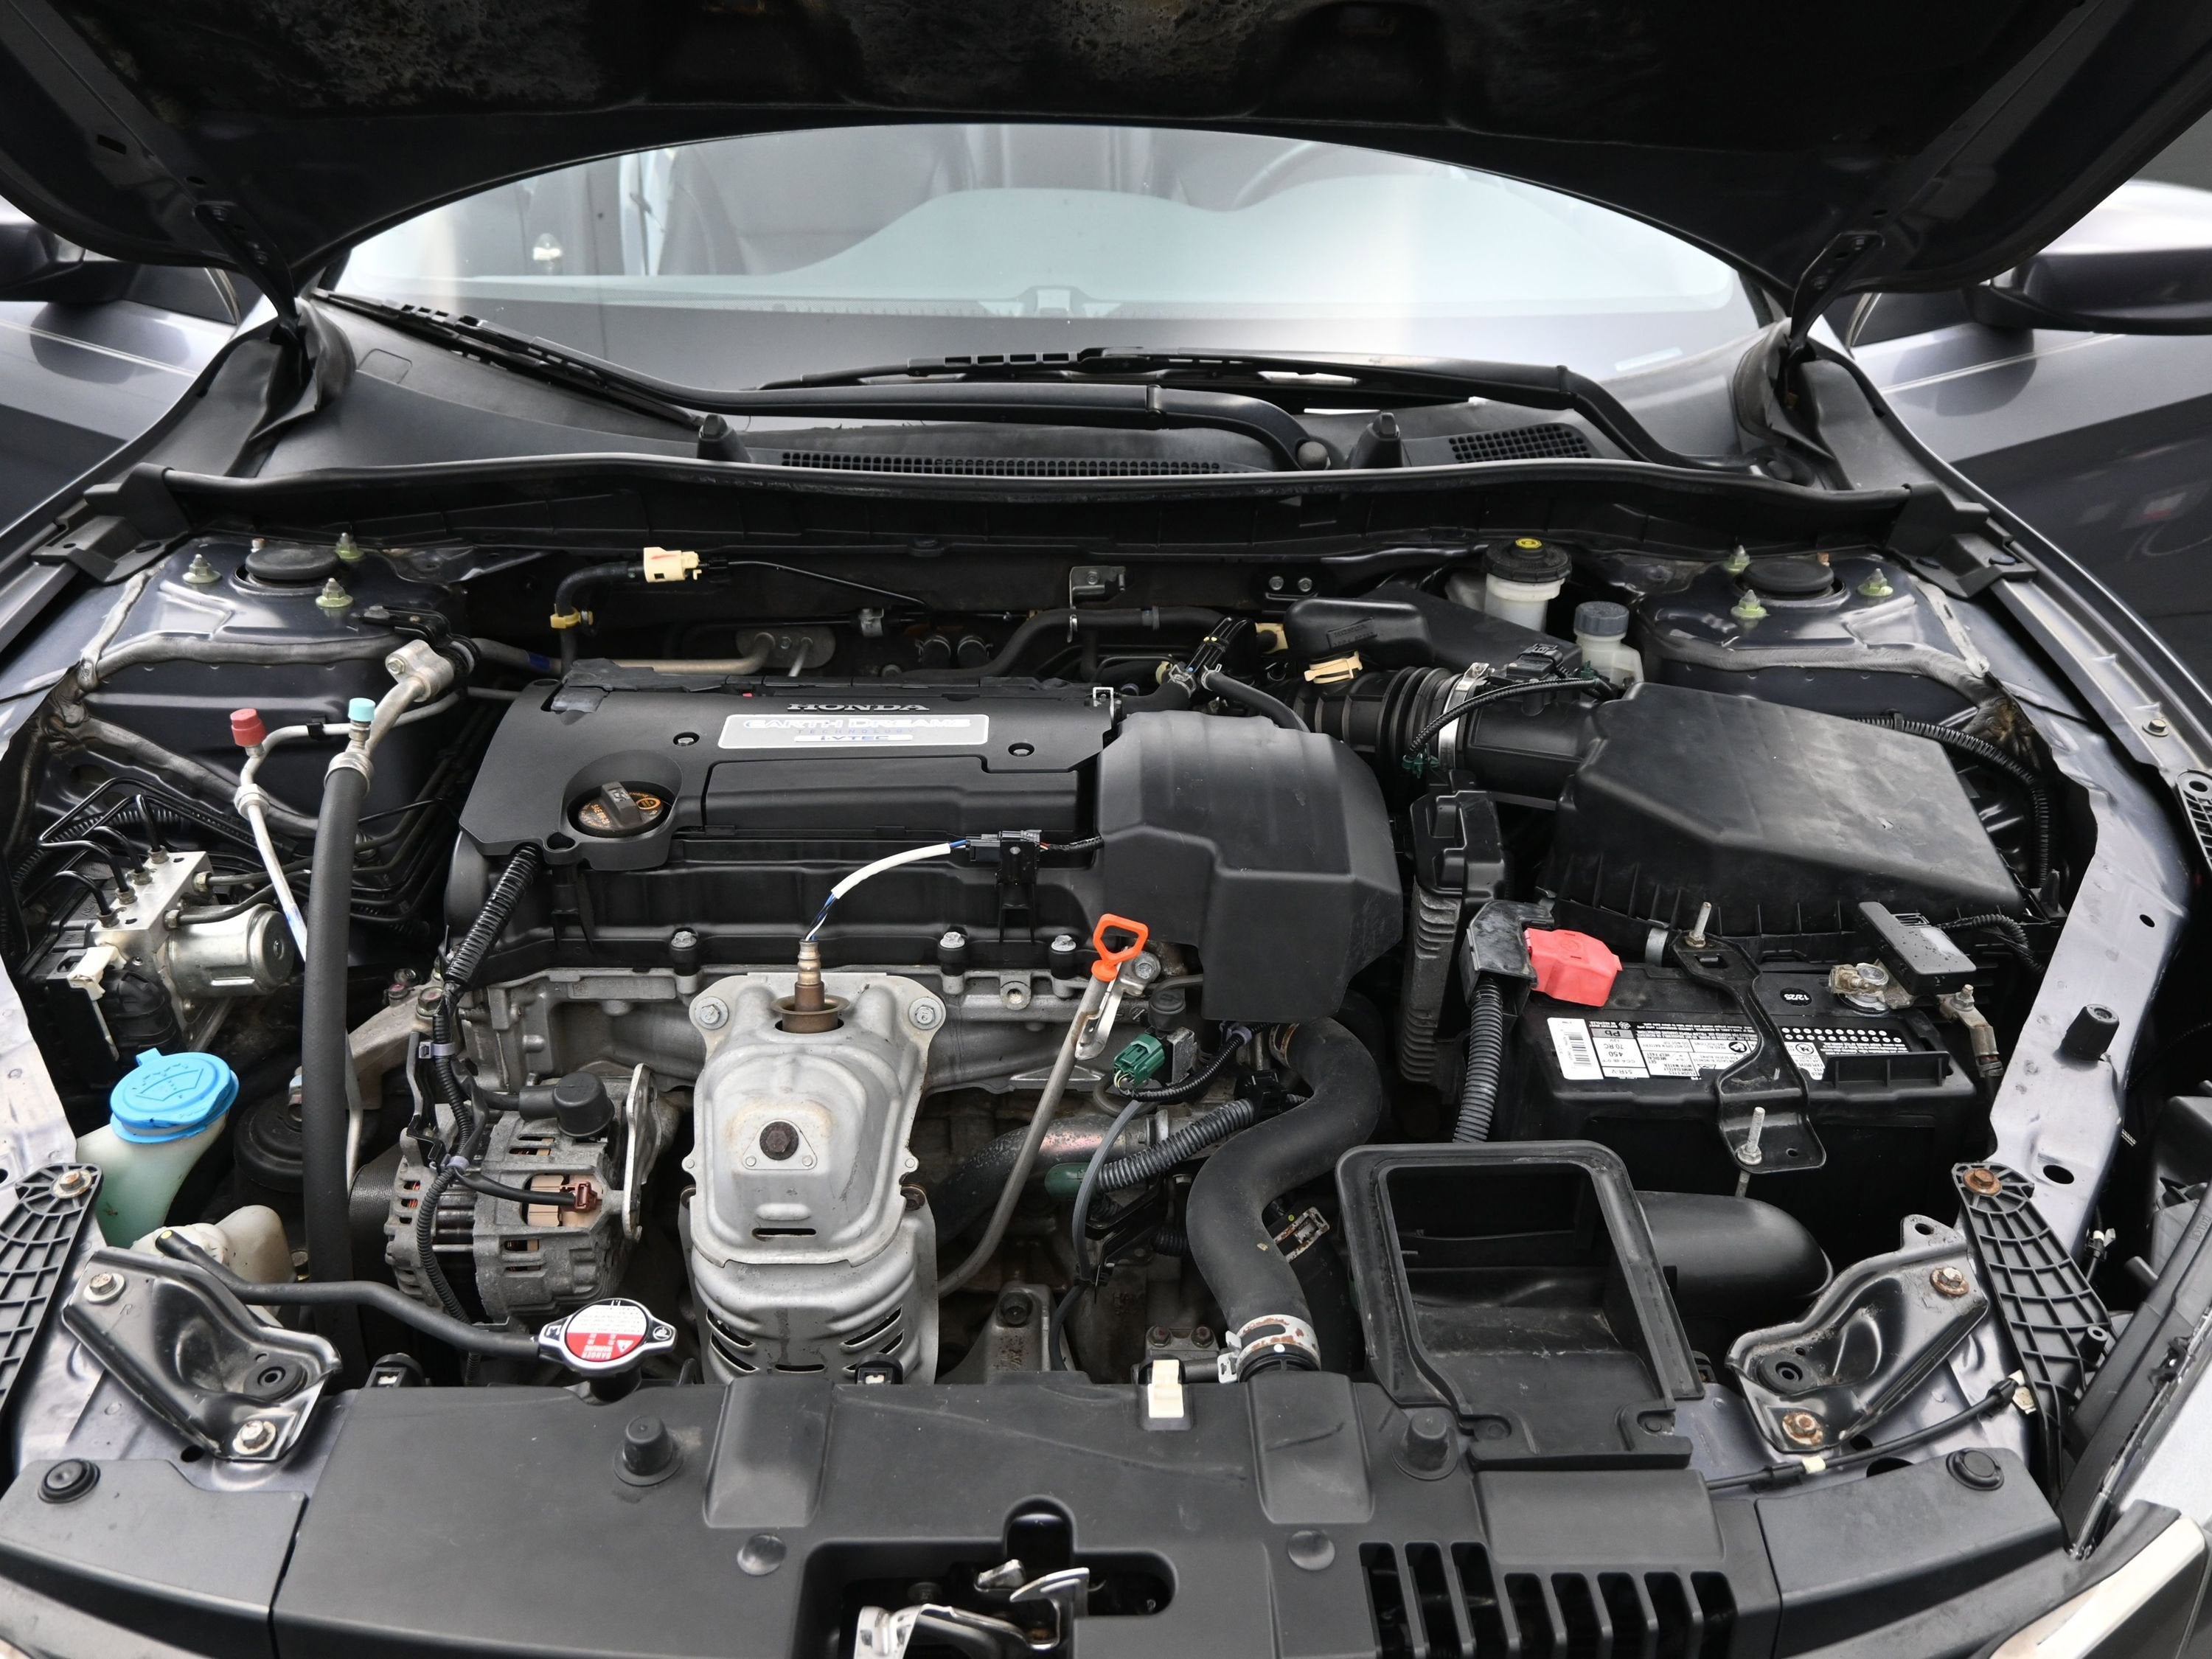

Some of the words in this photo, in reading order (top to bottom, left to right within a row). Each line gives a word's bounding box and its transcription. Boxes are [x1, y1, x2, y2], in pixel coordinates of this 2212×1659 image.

[787, 703, 930, 712] HONDA
[743, 719, 844, 728] EARTH
[848, 717, 970, 728] DREAMS
[581, 1351, 612, 1360] DANGER
